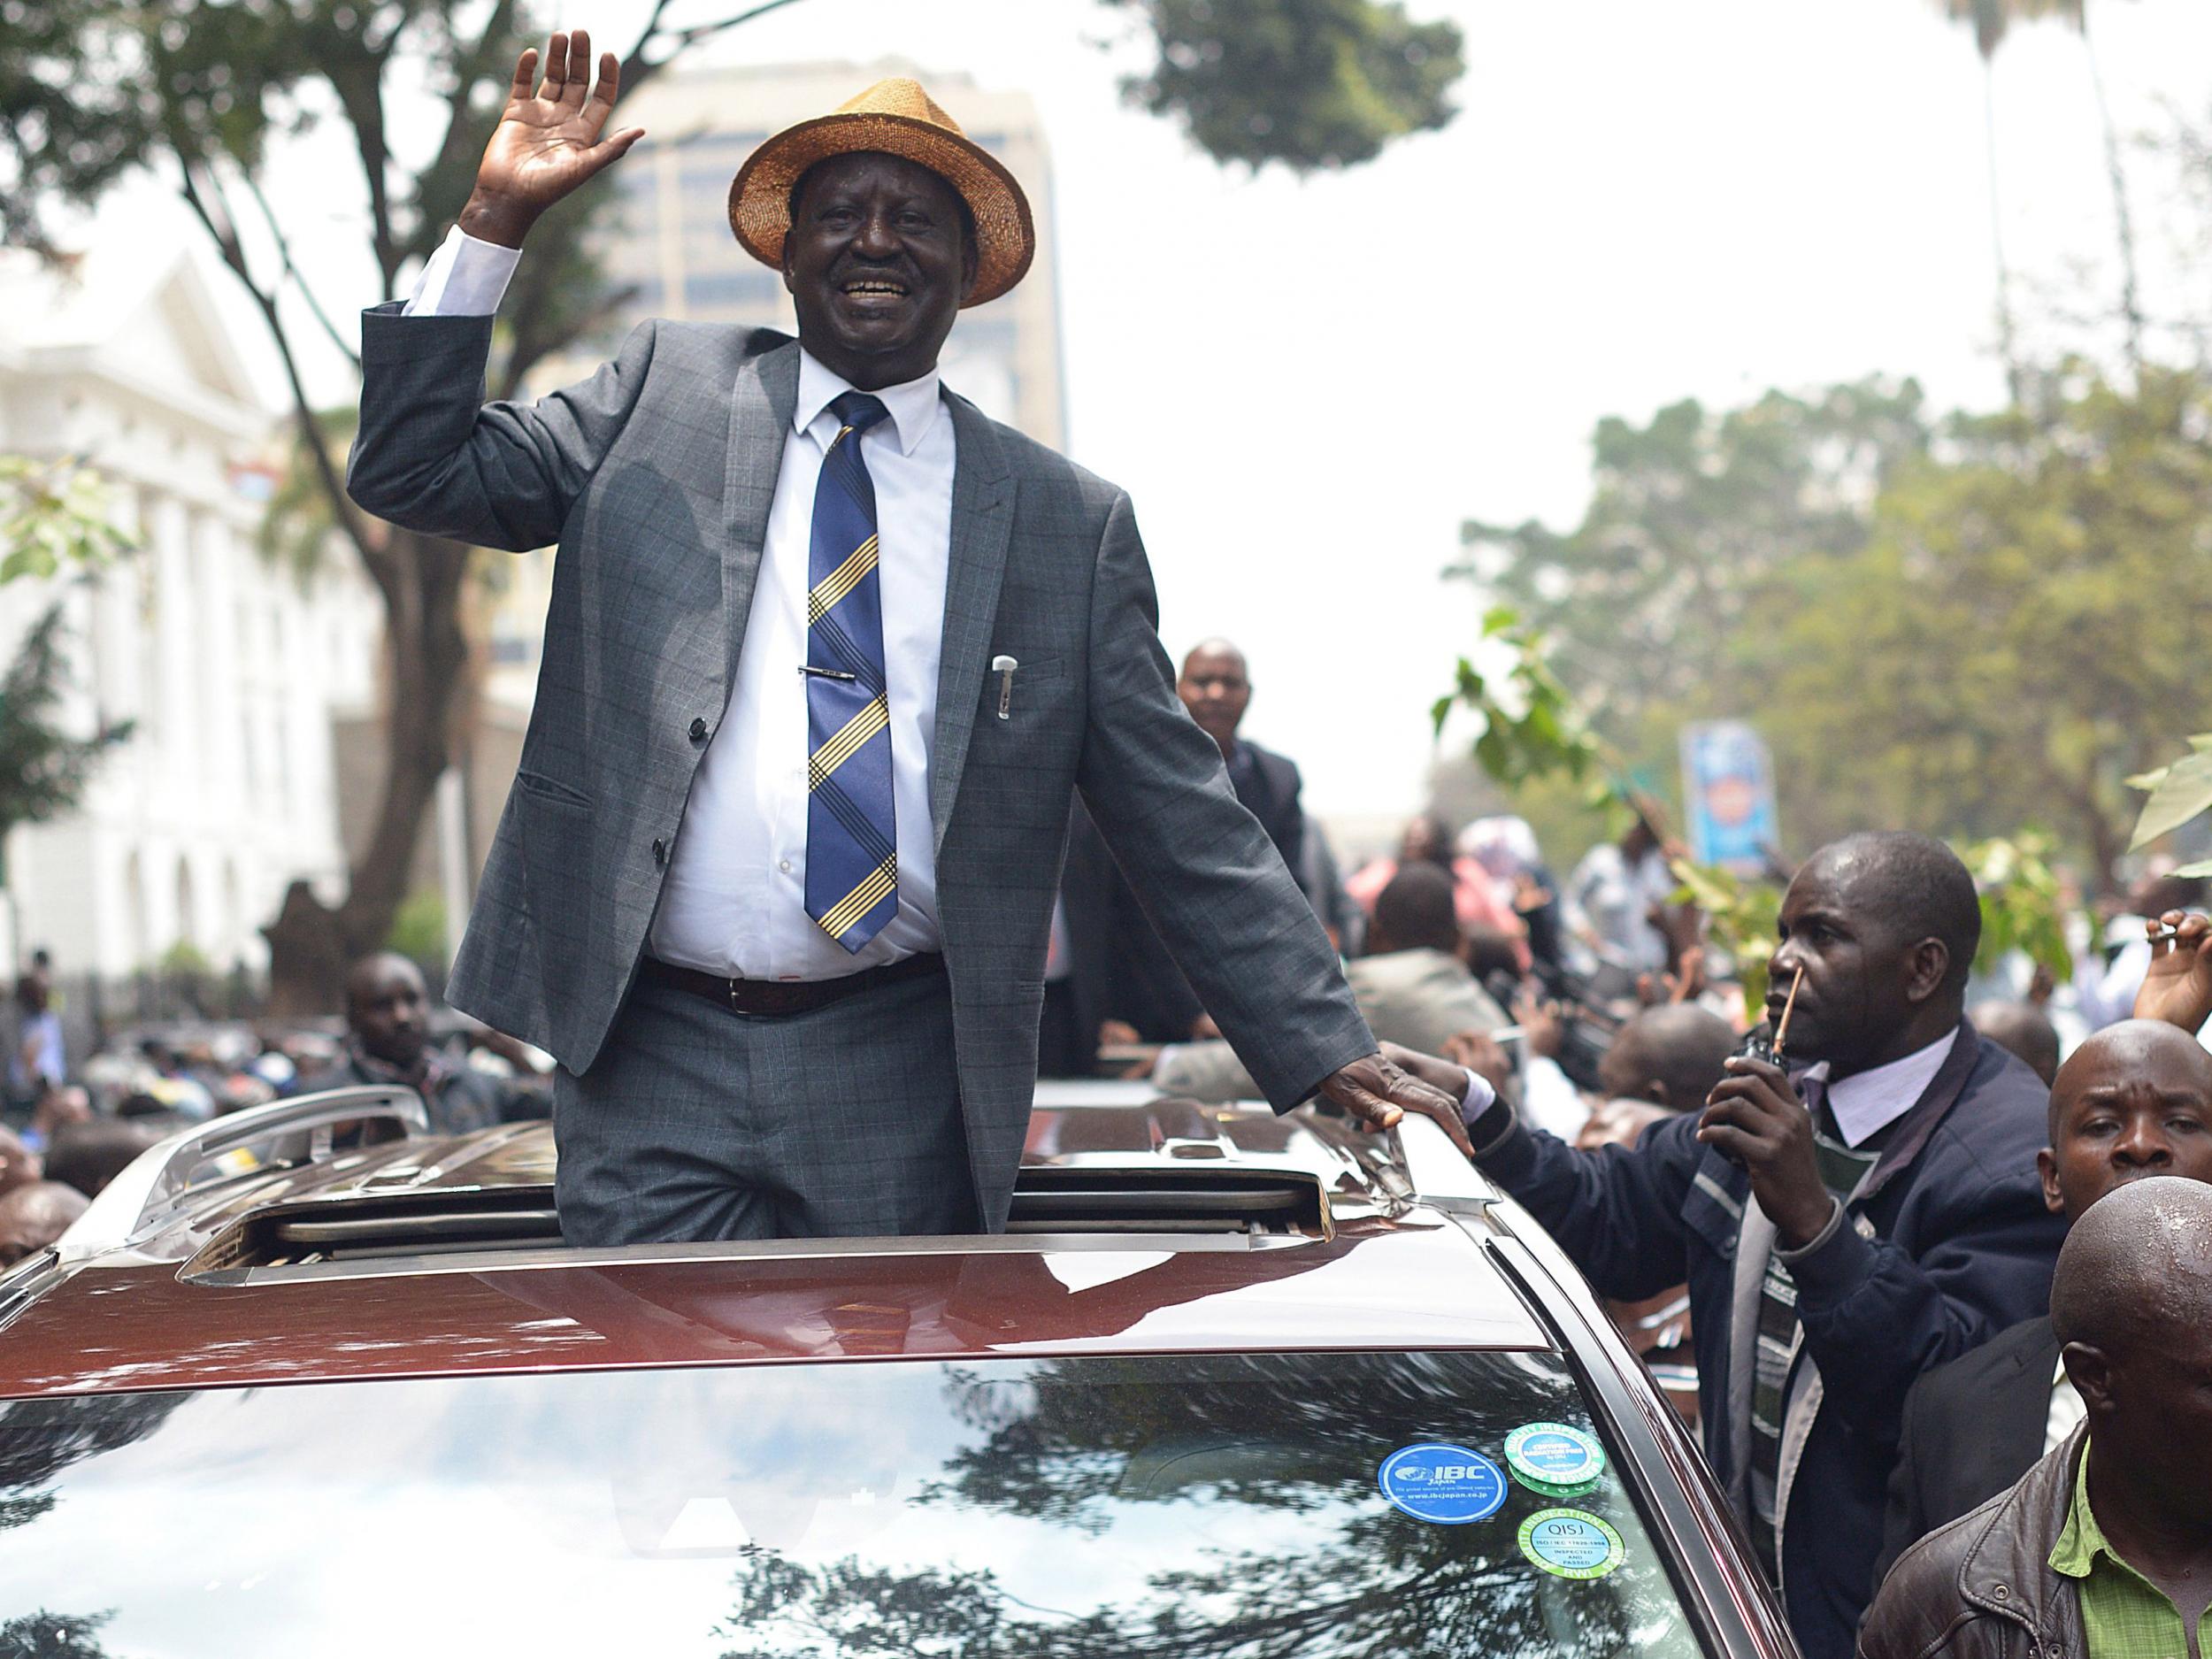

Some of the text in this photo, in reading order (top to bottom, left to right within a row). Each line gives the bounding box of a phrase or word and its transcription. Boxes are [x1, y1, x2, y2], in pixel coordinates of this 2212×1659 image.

[1434, 1465, 1486, 1479] IBC
[1525, 1509, 1601, 1529] INSPECTION
[1548, 1524, 1584, 1536] QISJ
